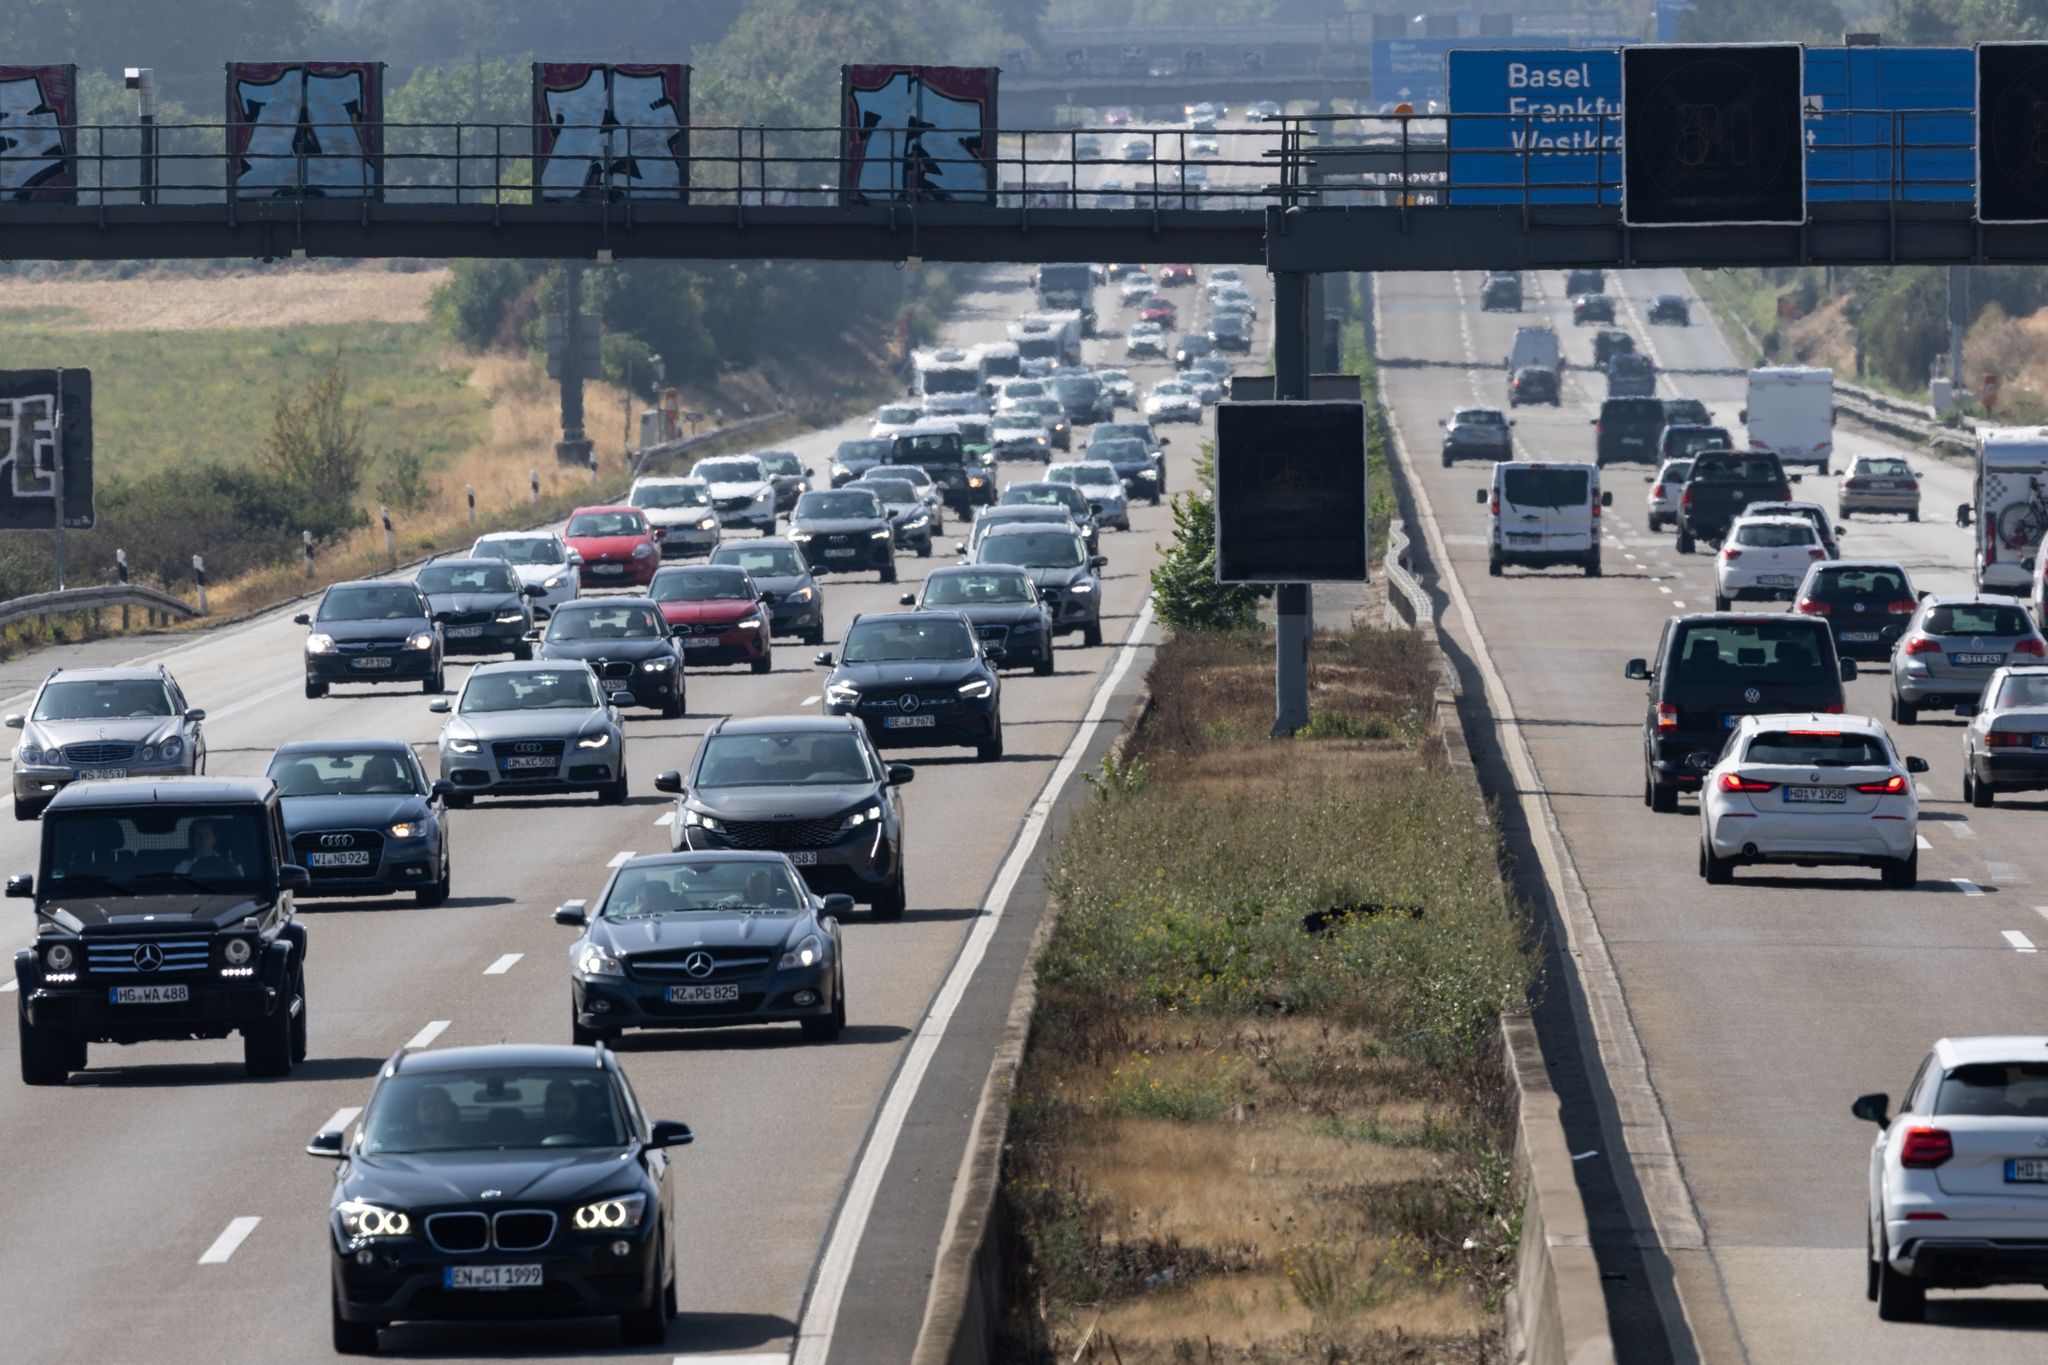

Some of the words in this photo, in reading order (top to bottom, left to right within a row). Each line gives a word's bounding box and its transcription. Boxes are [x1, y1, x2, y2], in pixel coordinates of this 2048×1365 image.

[1508, 63, 1591, 88] Basel
[1509, 97, 1622, 122] Frankfu
[1511, 129, 1623, 156] Westkre
[82, 771, 95, 780] WS
[1790, 789, 1804, 799] HD
[314, 855, 327, 865] WI
[332, 854, 347, 864] ND
[349, 853, 369, 864] 924
[119, 989, 136, 1001] HG
[142, 988, 161, 1001] WA
[163, 987, 187, 1000] 488
[671, 988, 687, 999] MZ
[695, 988, 711, 999] PG
[714, 987, 737, 999] 825
[2017, 1162, 2034, 1177] HD
[455, 1269, 472, 1285] EN
[481, 1268, 501, 1285] CT
[506, 1267, 542, 1284] 1999
